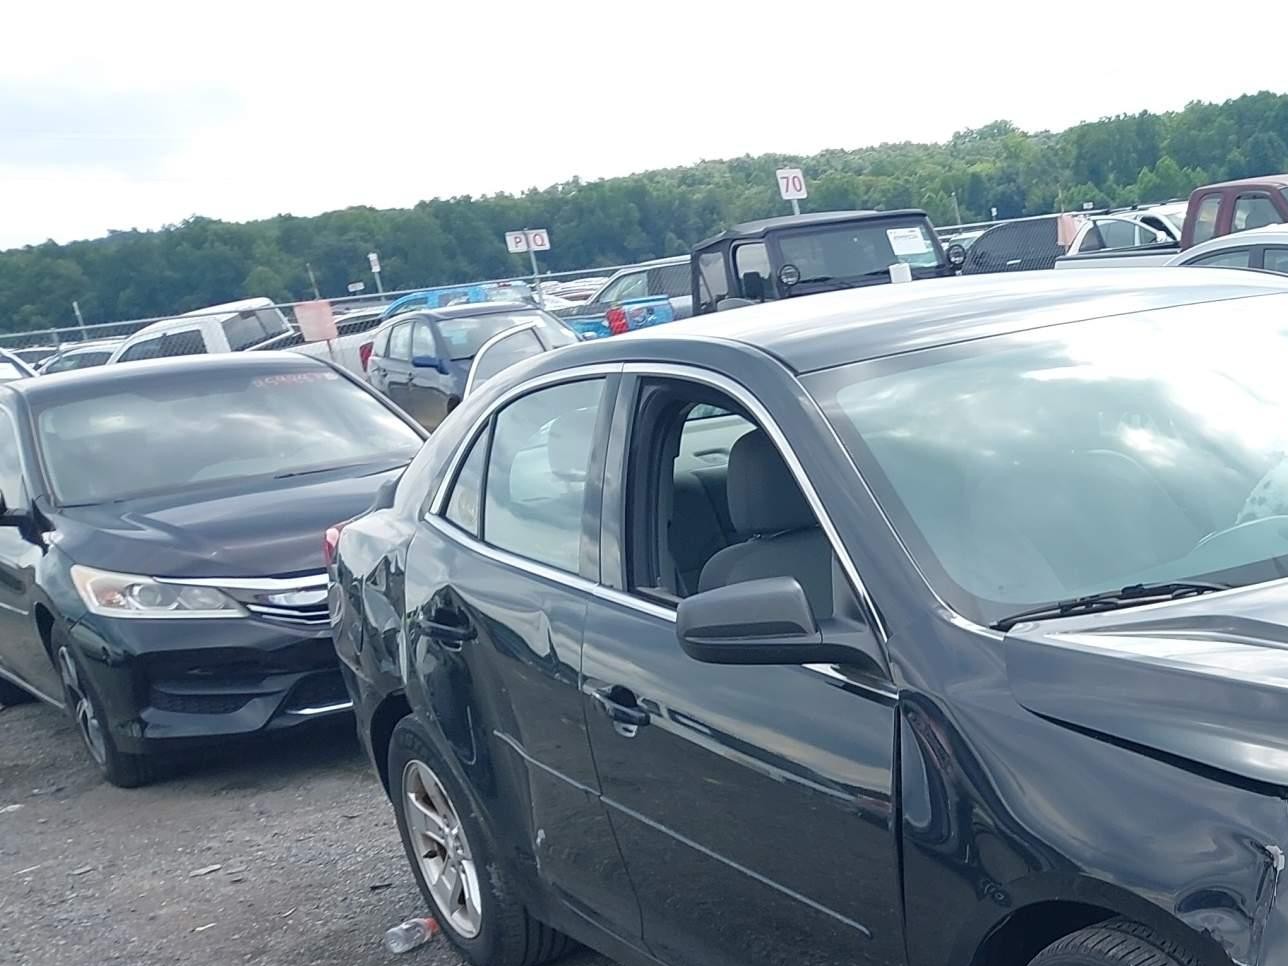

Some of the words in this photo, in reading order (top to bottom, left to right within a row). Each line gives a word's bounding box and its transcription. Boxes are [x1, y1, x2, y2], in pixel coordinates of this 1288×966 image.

[779, 175, 803, 193] 70
[514, 236, 523, 249] P
[532, 233, 547, 247] Q
